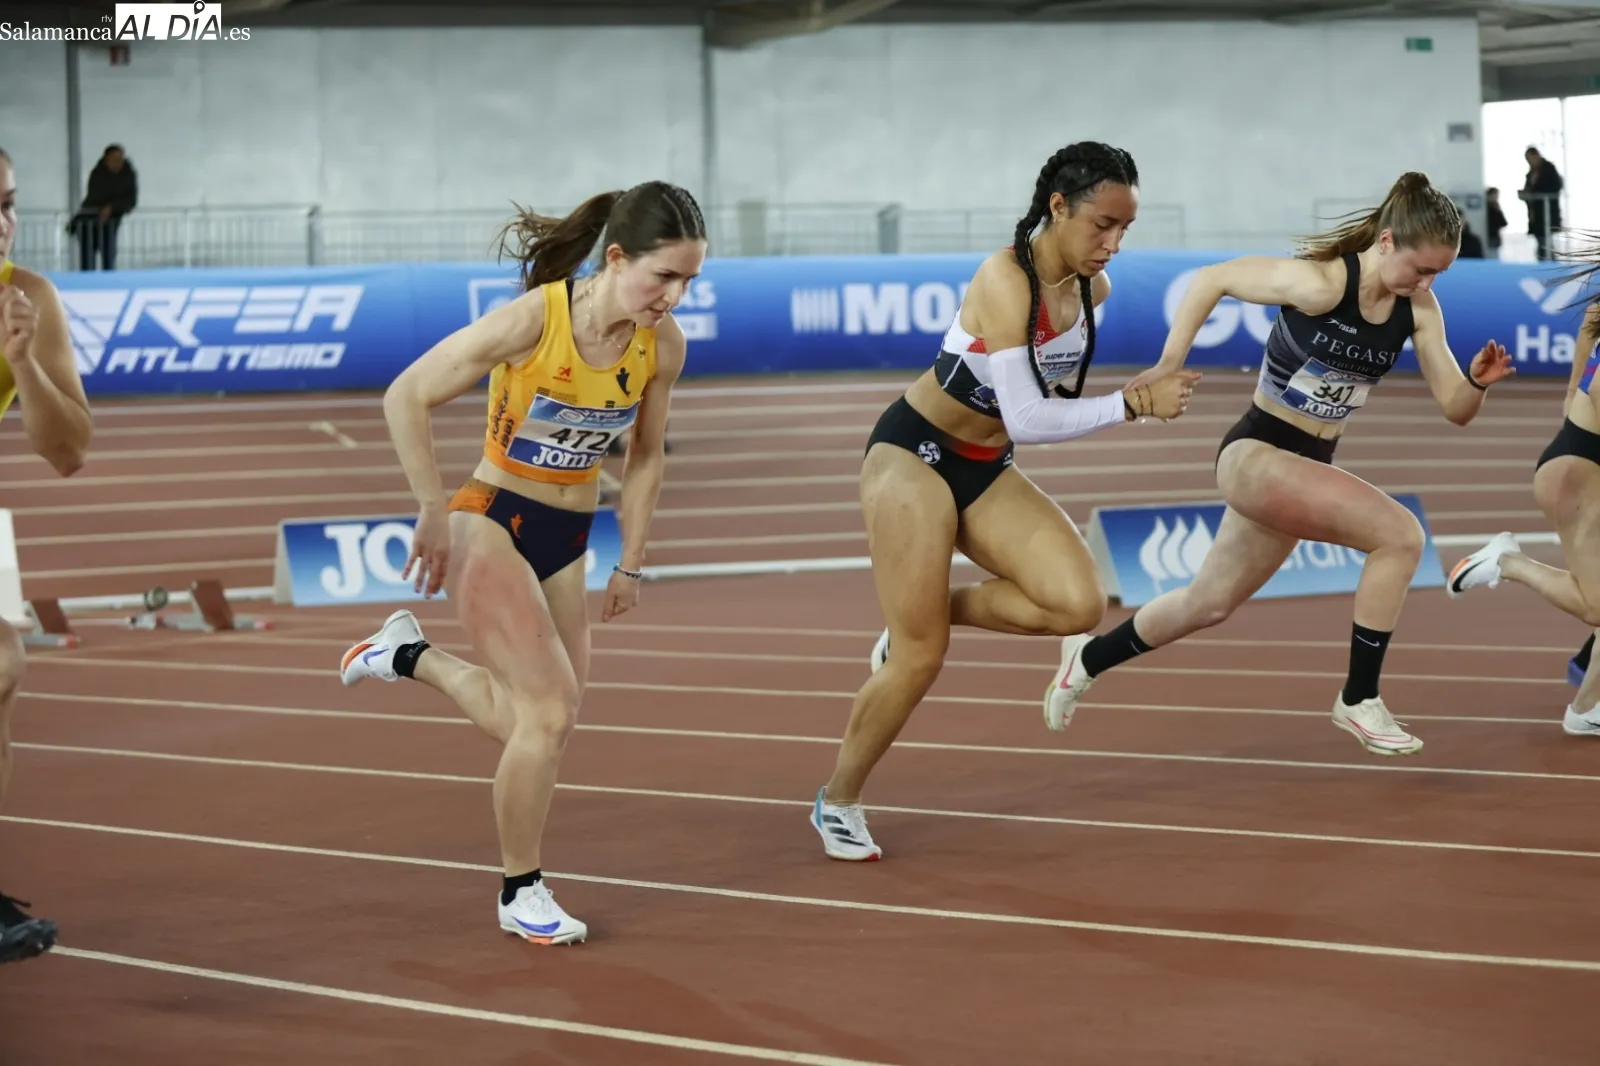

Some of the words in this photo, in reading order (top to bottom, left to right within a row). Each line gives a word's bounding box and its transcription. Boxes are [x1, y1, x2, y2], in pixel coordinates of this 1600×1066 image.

[116, 284, 365, 348] RFEA
[842, 282, 967, 335] MO
[104, 342, 347, 375] ATLETISMO
[548, 427, 611, 451] 472
